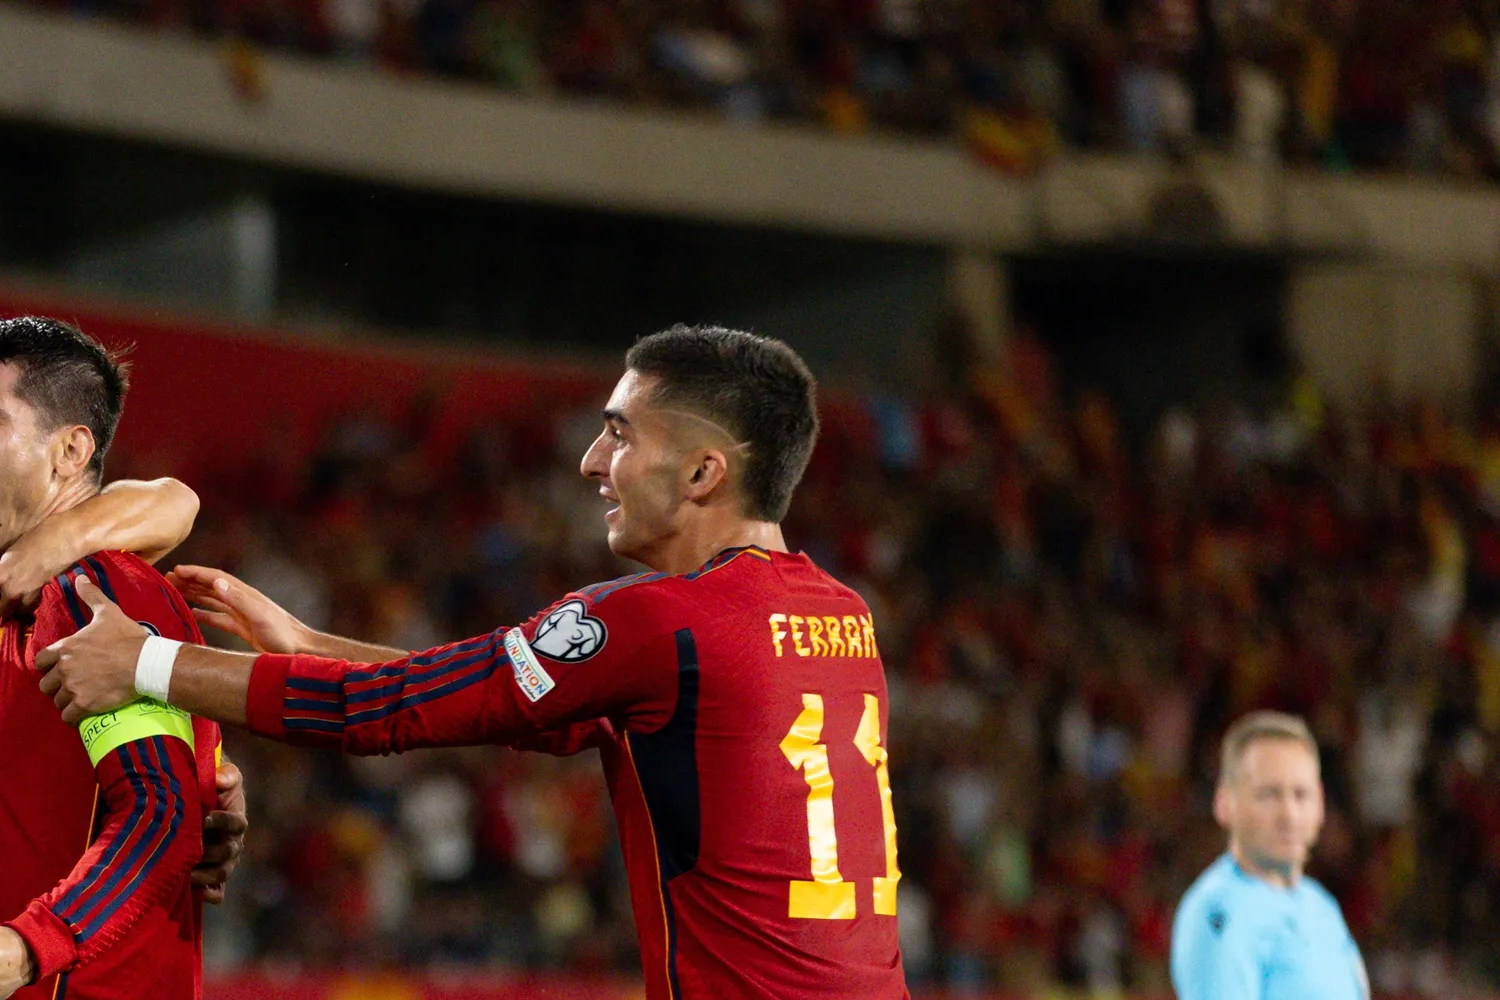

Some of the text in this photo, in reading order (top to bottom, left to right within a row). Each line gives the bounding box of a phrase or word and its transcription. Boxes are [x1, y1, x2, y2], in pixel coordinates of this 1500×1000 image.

[504, 632, 547, 695] UNDATION
[768, 612, 877, 658] FERRAN
[779, 693, 902, 920] 11
